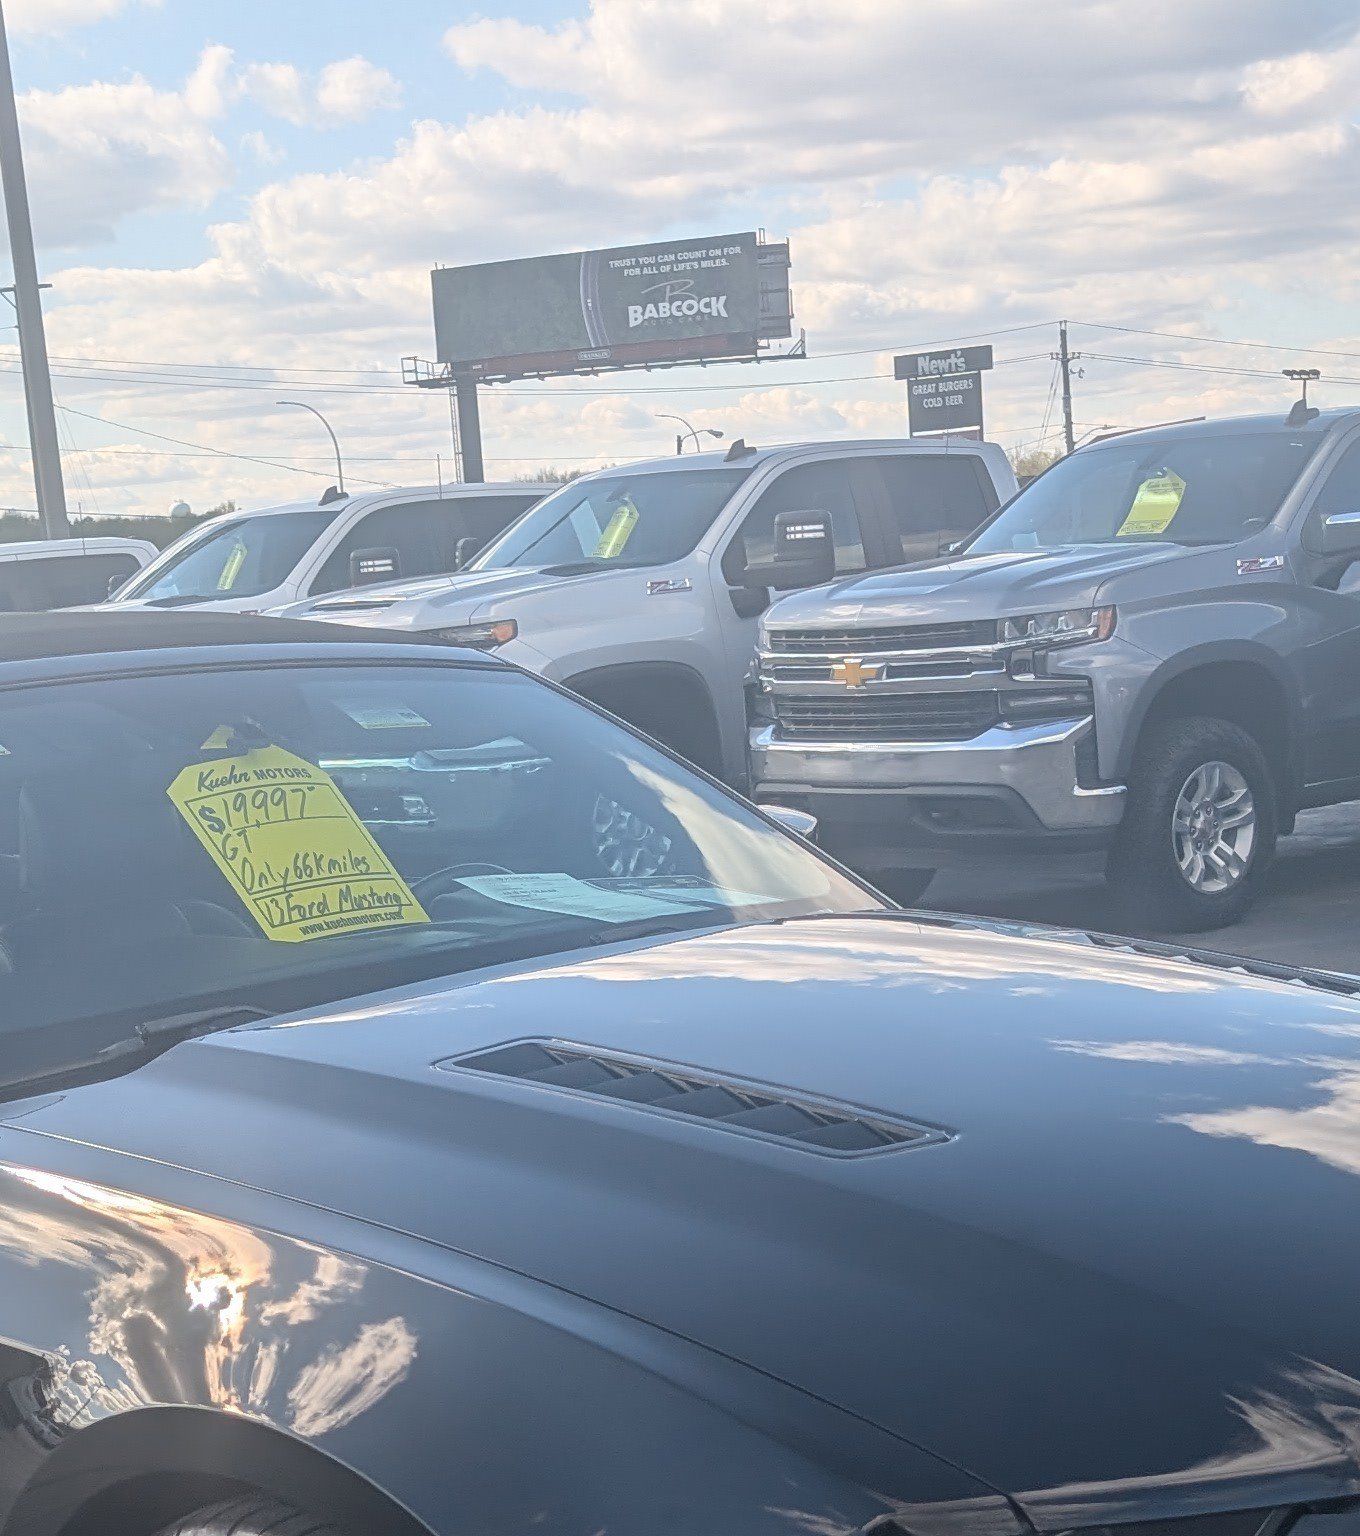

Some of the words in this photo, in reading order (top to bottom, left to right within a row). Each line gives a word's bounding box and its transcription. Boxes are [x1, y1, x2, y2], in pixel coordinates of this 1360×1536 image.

[609, 258, 636, 268] TRUST
[638, 256, 655, 265] YOU
[657, 254, 675, 263] CAN
[677, 249, 708, 260] COUNT
[708, 248, 722, 257] ON
[723, 246, 741, 256] FOR
[624, 267, 641, 277] FOR
[642, 266, 658, 275] ALL
[660, 264, 672, 273] OF
[673, 261, 699, 271] LIFE'S
[627, 295, 729, 328] BABCOCK
[916, 351, 966, 376] Newt's
[912, 382, 936, 395] GREAT
[938, 379, 974, 393] BURGERS
[923, 396, 943, 409] COLD
[945, 395, 964, 407] BEER
[197, 764, 251, 792] Kuehn
[252, 767, 313, 782] MOTORS
[221, 828, 253, 862] GT
[240, 857, 290, 893] Only
[338, 884, 402, 914] Mustang
